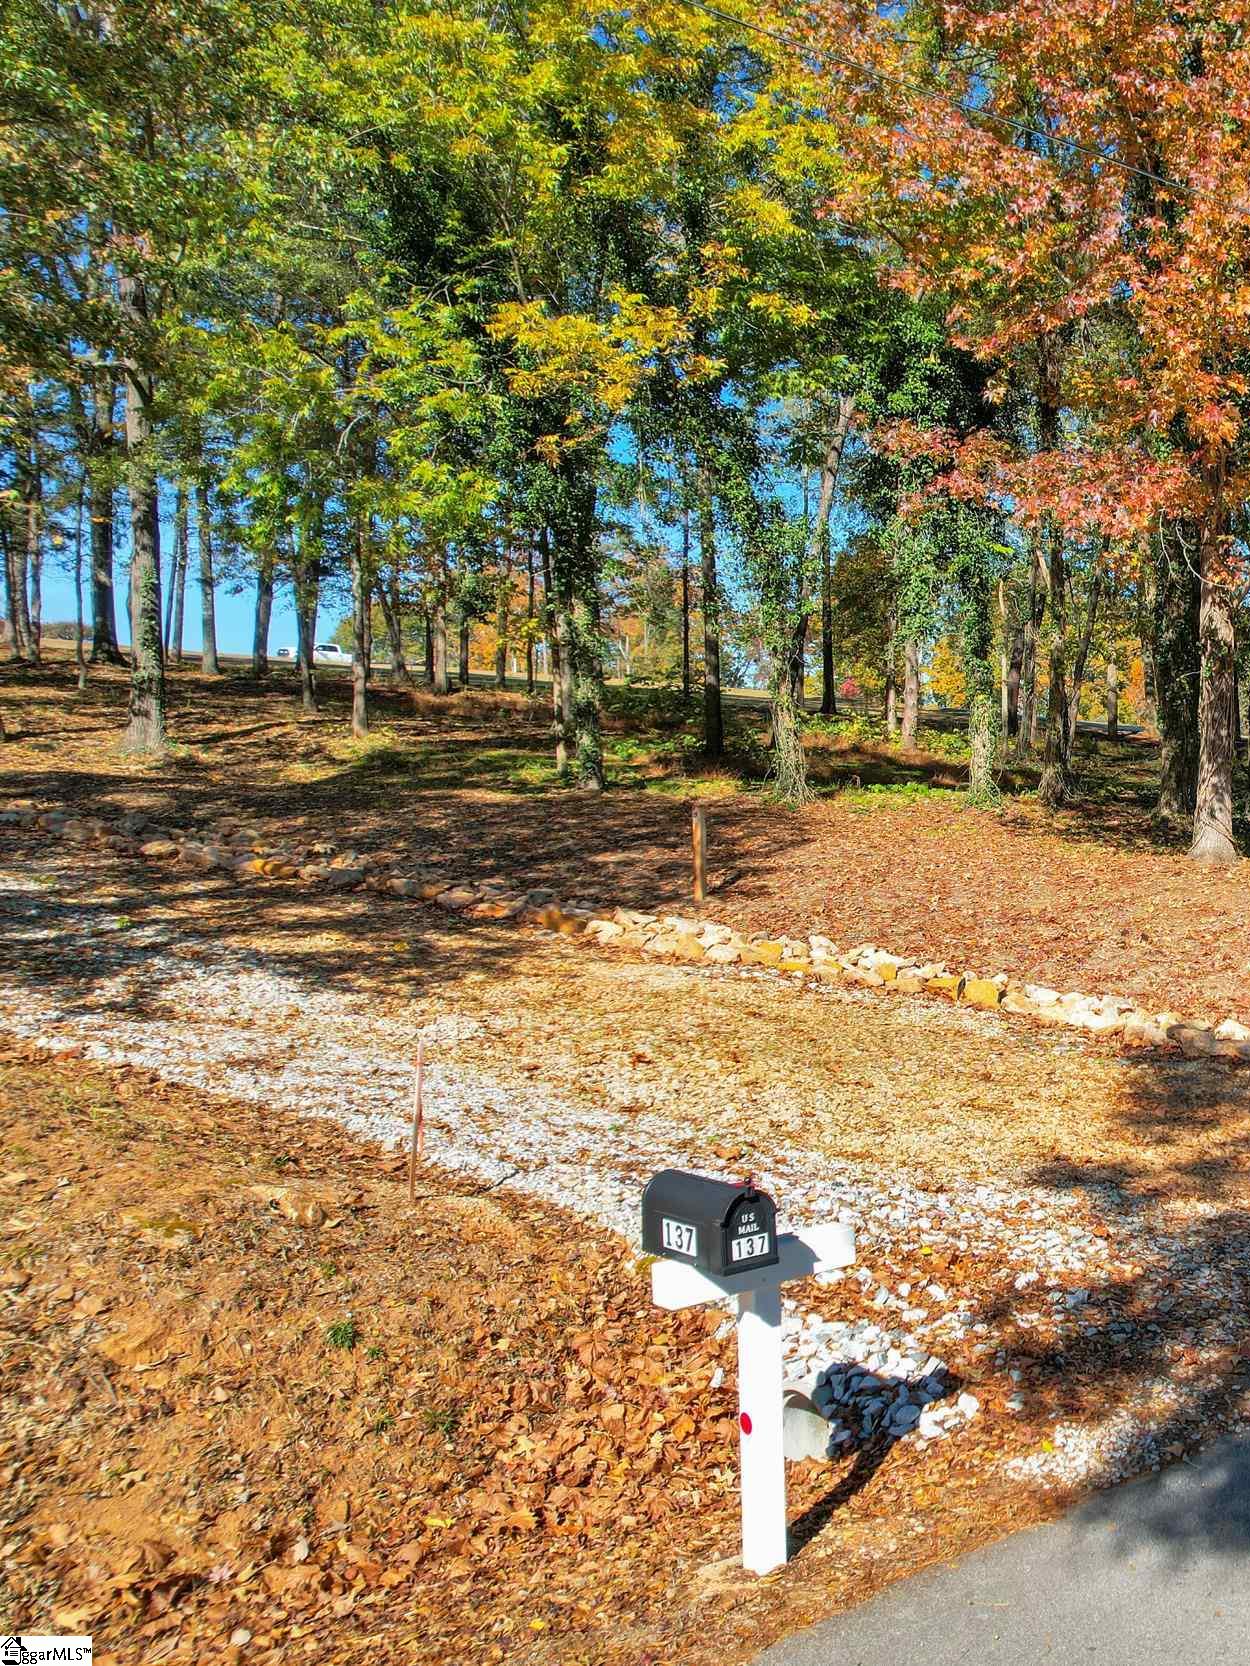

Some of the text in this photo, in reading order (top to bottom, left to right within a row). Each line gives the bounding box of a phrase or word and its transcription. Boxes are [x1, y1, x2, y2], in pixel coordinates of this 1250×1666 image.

[665, 1221, 694, 1253] 137
[738, 1223, 760, 1235] MAIL
[735, 1235, 766, 1258] 137
